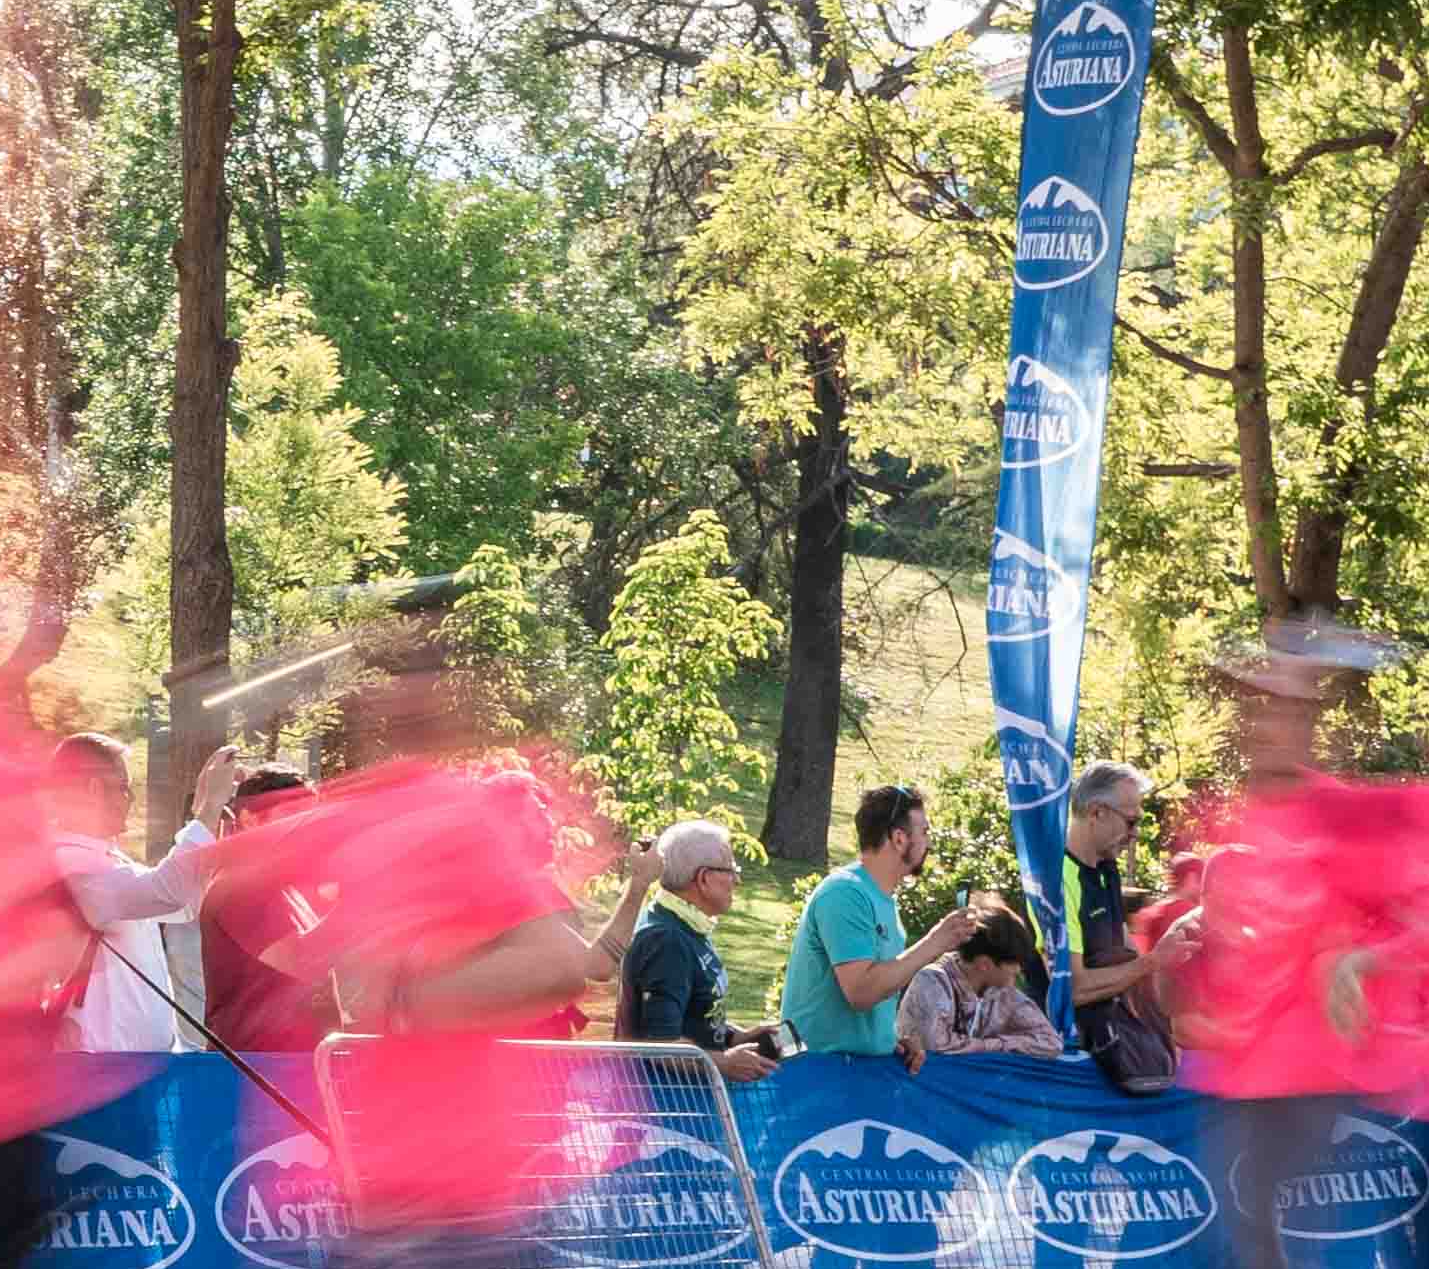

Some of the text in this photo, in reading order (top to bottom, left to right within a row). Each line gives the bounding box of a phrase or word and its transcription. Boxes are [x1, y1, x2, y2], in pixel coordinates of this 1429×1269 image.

[1037, 48, 1123, 89] ASTURIANA
[1030, 1174, 1206, 1225] ASTURIANA
[1274, 1164, 1420, 1210] STURIANA
[37, 1207, 179, 1250] RIANA
